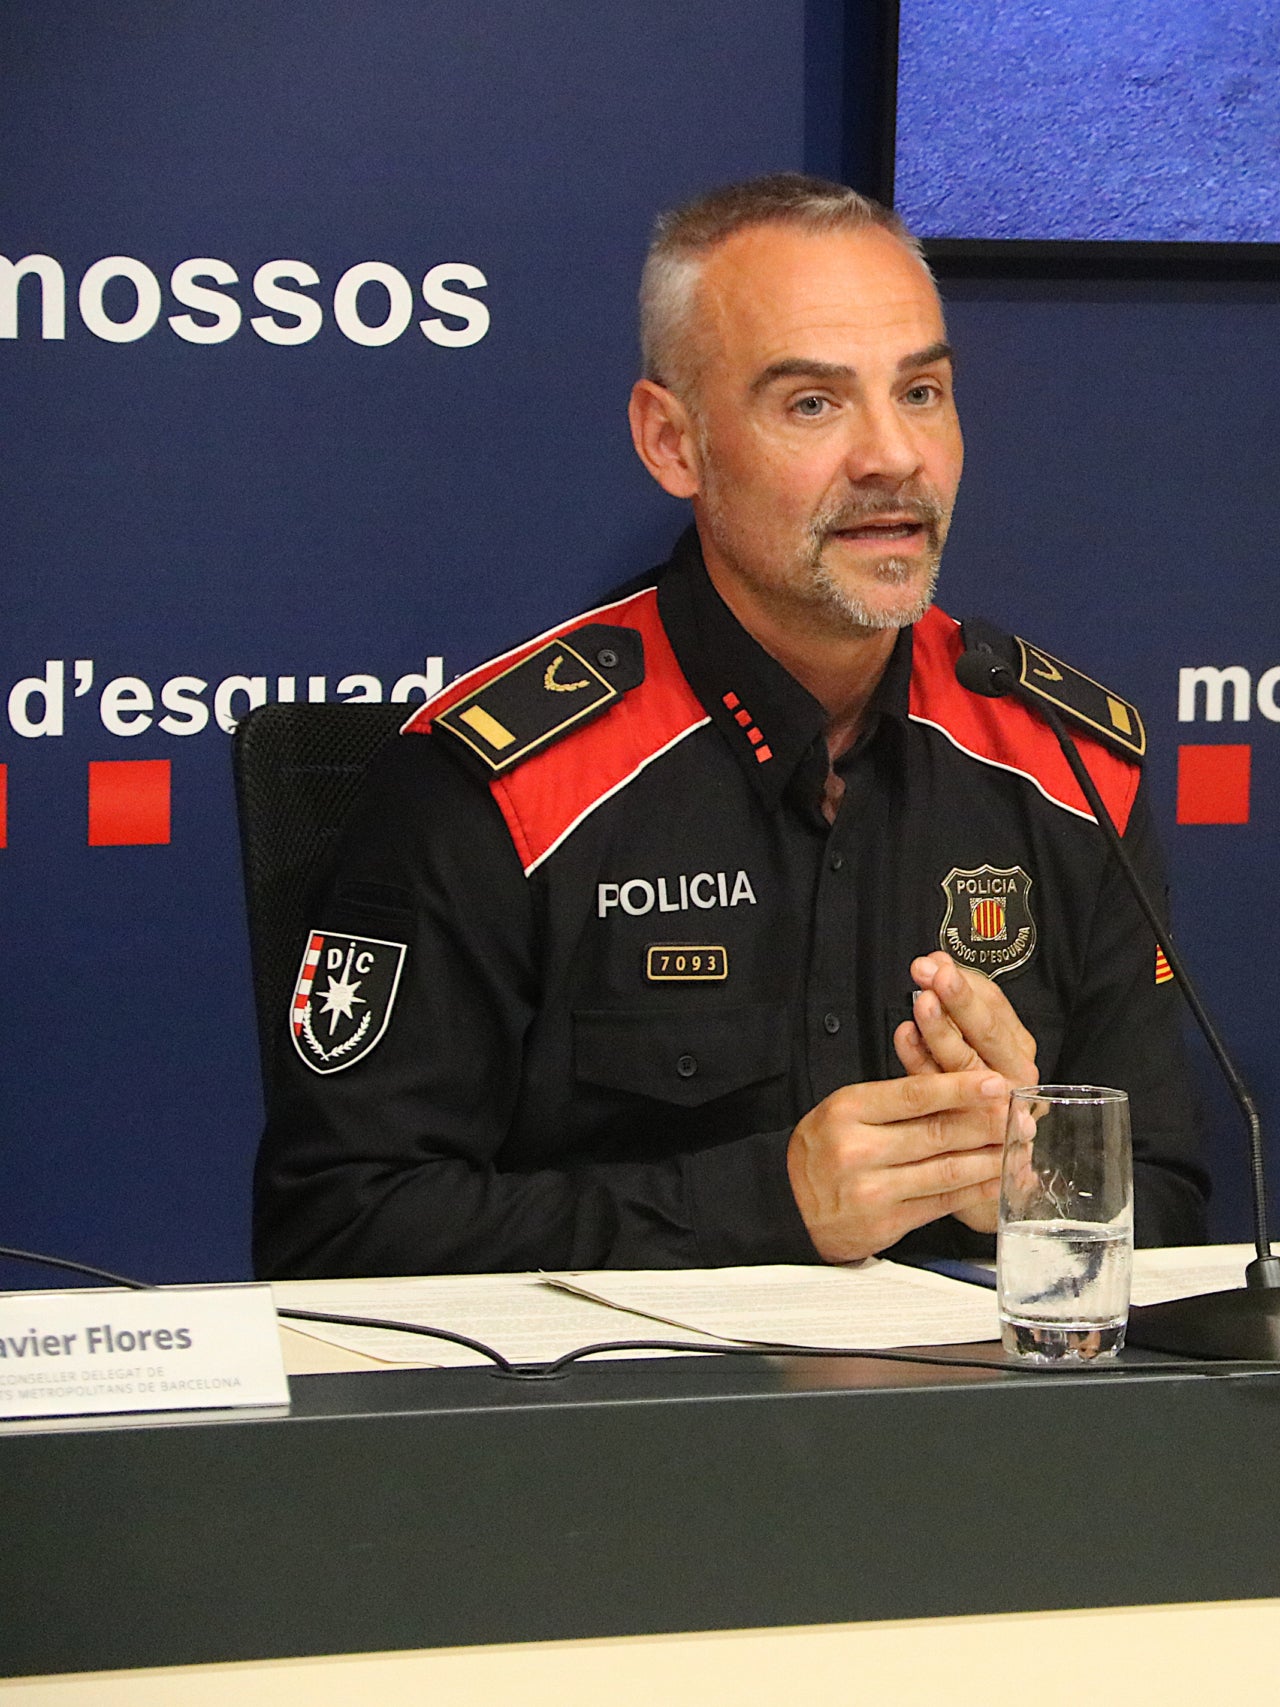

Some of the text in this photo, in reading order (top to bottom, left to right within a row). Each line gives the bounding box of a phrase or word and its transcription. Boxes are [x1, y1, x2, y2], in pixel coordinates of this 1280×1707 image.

[0, 252, 490, 348] mossos
[598, 870, 757, 918] POLICIA
[957, 878, 1018, 895] POLICIA
[946, 926, 1031, 964] MOSSOS D'ESQUADRA
[660, 956, 716, 972] 7093
[0, 1324, 193, 1358] vier Flores
[18, 1382, 133, 1400] METROPOLITANS
[138, 1381, 156, 1394] DE
[160, 1376, 242, 1392] BARCELONA
[81, 1367, 141, 1382] DELEGAT
[146, 1365, 164, 1378] DE
